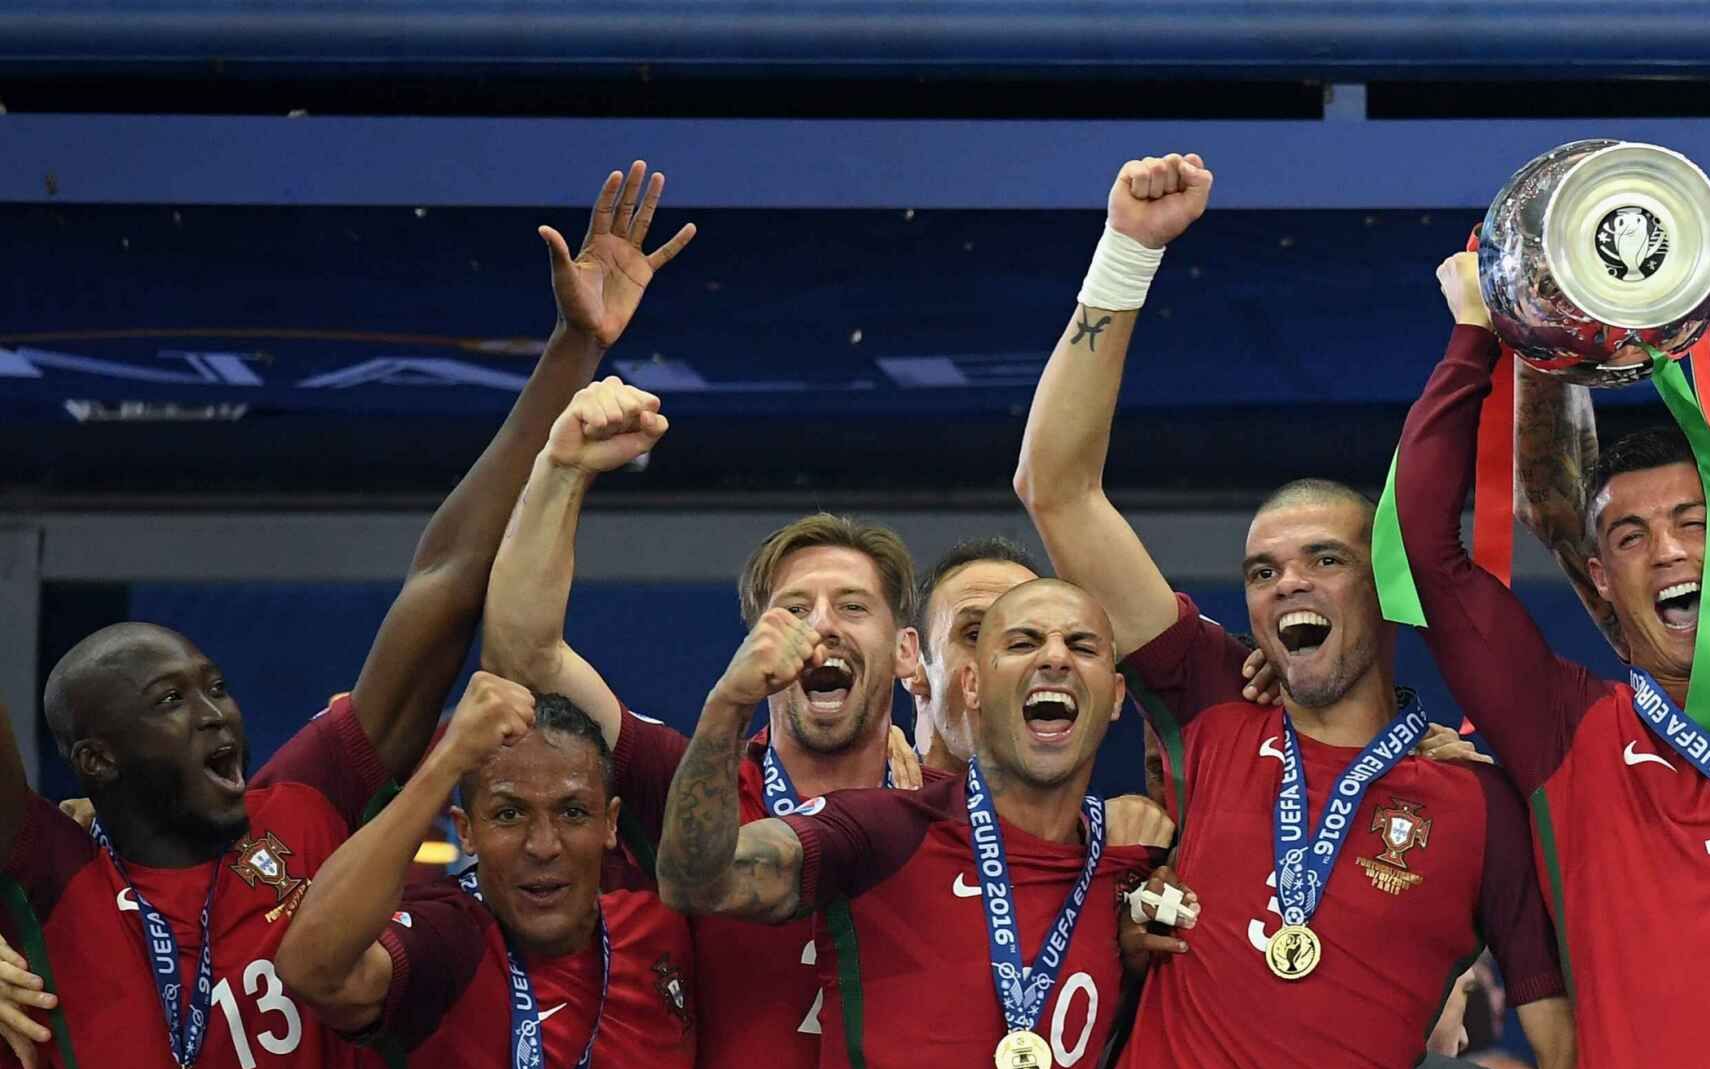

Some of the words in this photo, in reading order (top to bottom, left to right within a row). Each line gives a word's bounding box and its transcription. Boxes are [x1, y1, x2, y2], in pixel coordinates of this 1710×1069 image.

[1371, 712, 1425, 760] UEFA
[1339, 754, 1385, 797] EURO
[969, 809, 1002, 878] EURO
[1279, 784, 1303, 842] UEFA
[1042, 907, 1076, 968] UEFA
[1073, 839, 1101, 906] EURO
[146, 911, 176, 974] UEFA
[1050, 971, 1099, 1068] 0
